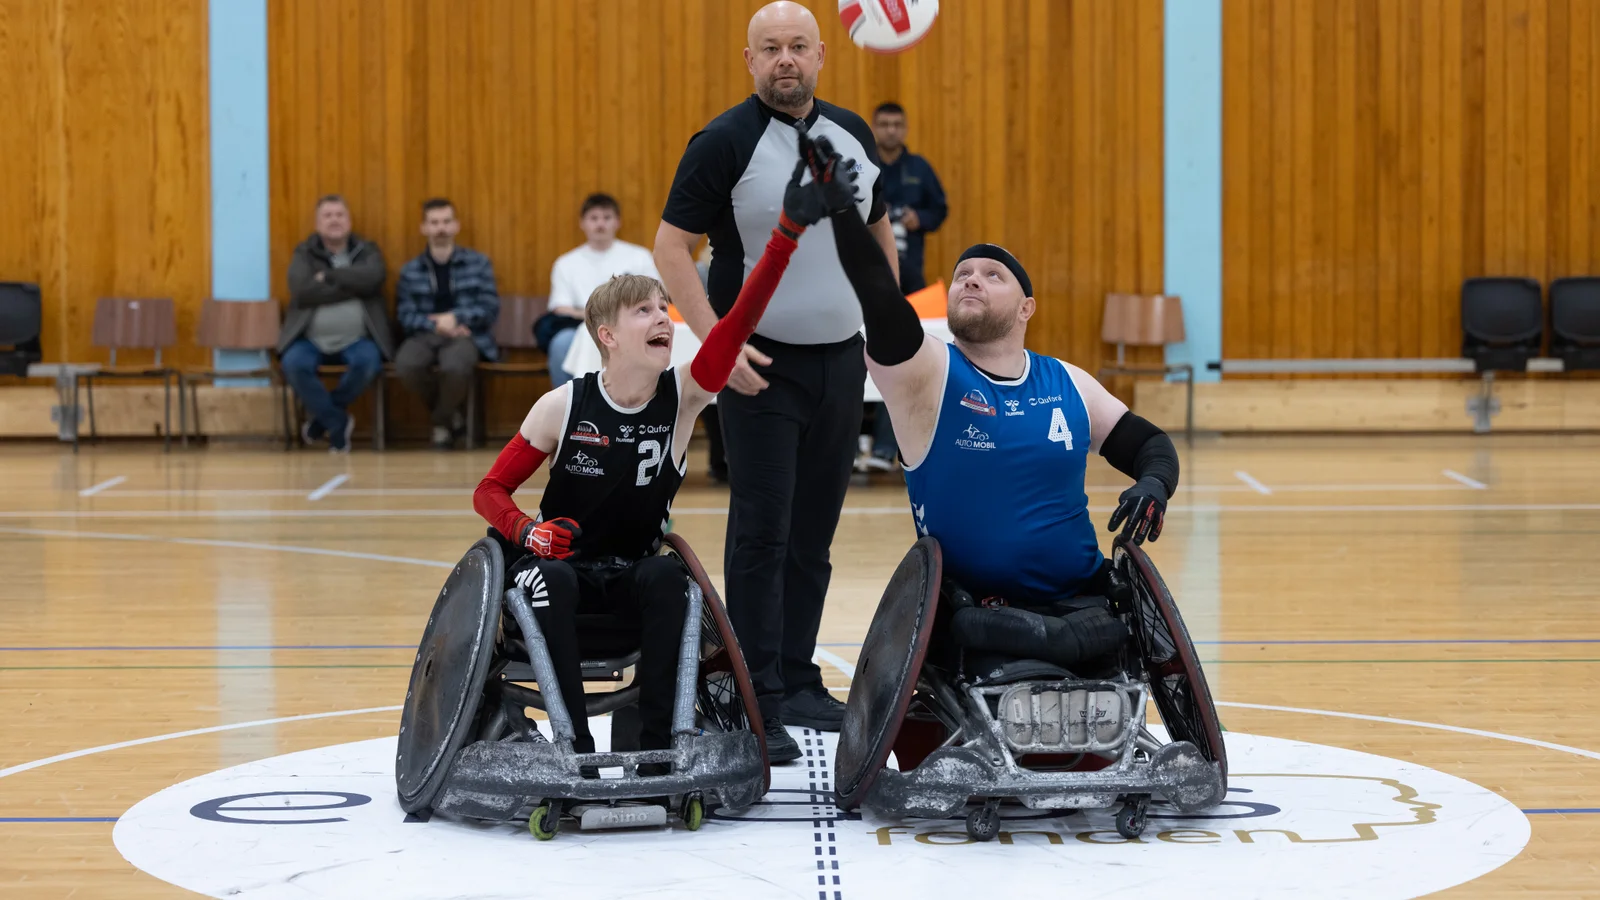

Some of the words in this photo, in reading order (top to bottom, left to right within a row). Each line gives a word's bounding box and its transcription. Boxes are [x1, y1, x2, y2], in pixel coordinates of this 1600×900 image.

[647, 424, 671, 433] Qufor
[1048, 408, 1073, 450] 4
[955, 439, 972, 447] AUTO
[565, 464, 581, 472] AUTO
[582, 467, 604, 475] MOBIL
[601, 810, 648, 823] rhino
